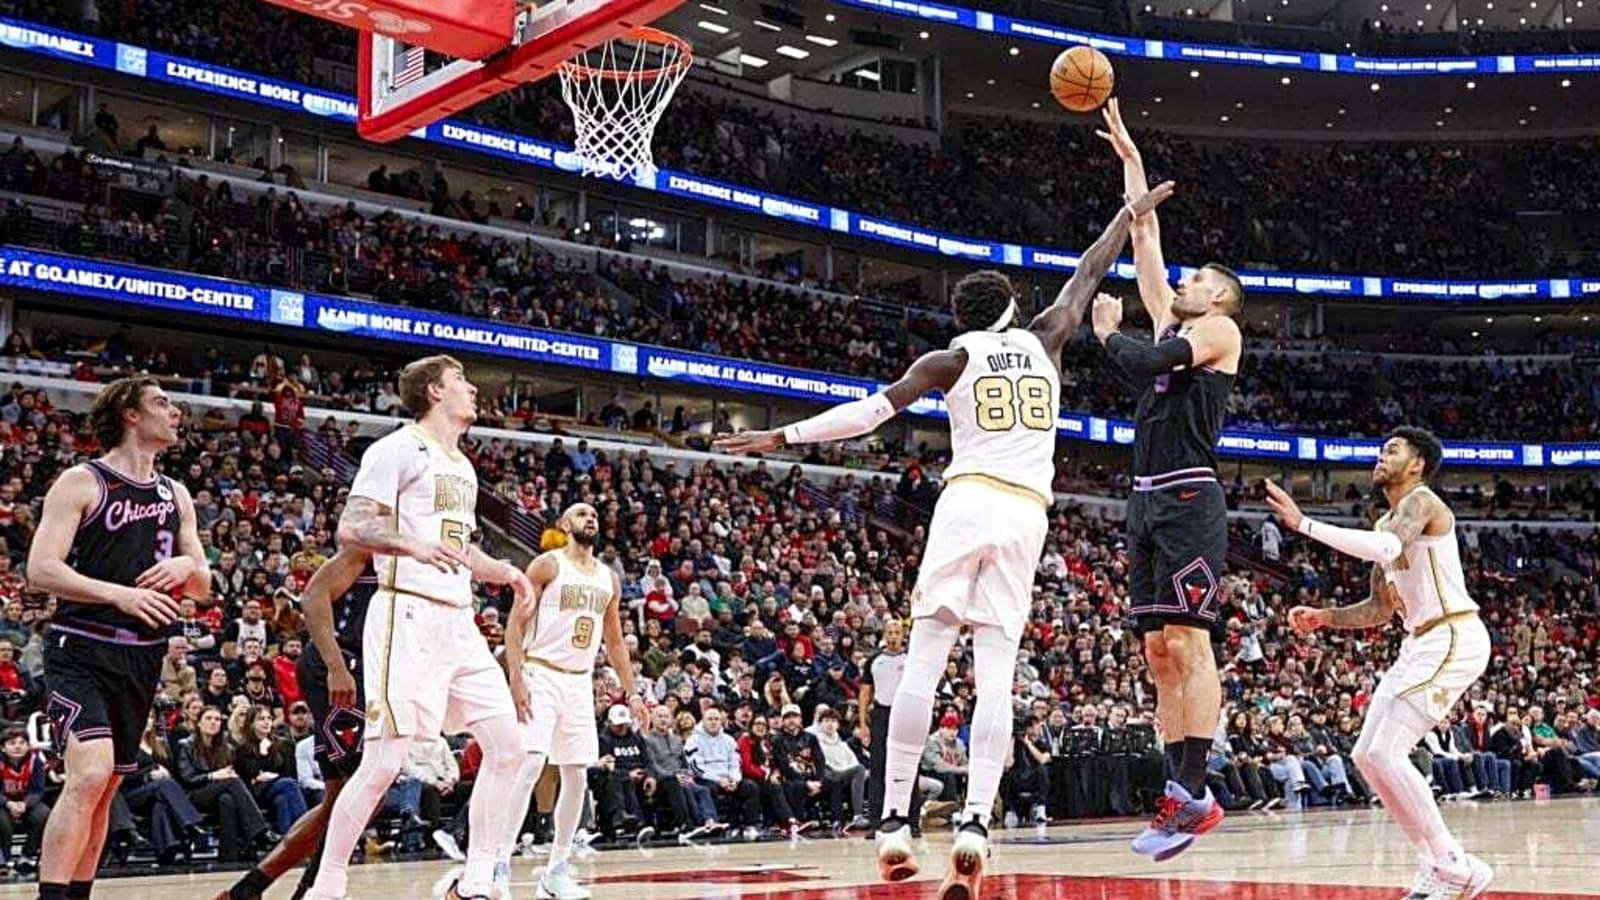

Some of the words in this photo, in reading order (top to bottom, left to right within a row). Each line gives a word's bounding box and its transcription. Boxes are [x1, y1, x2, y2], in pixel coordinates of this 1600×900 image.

[166, 62, 257, 94] EXPERIENCE
[259, 84, 300, 103] MORE
[442, 124, 516, 151] EXPERIENCE
[517, 141, 552, 160] MORE
[8, 260, 33, 277] AT
[35, 264, 254, 311] GO.AMEX/UNITED-CENTER
[318, 307, 368, 329] LEARN
[370, 315, 411, 334] MORE
[412, 321, 431, 336] AT
[432, 323, 600, 361] GO.AMEX/UNITED-CENTER
[688, 360, 721, 379] MORE
[987, 353, 1032, 373] QUETA
[973, 375, 1054, 432] 88
[105, 499, 176, 532] Chicago
[154, 529, 174, 562] 3
[571, 616, 595, 650] 9
